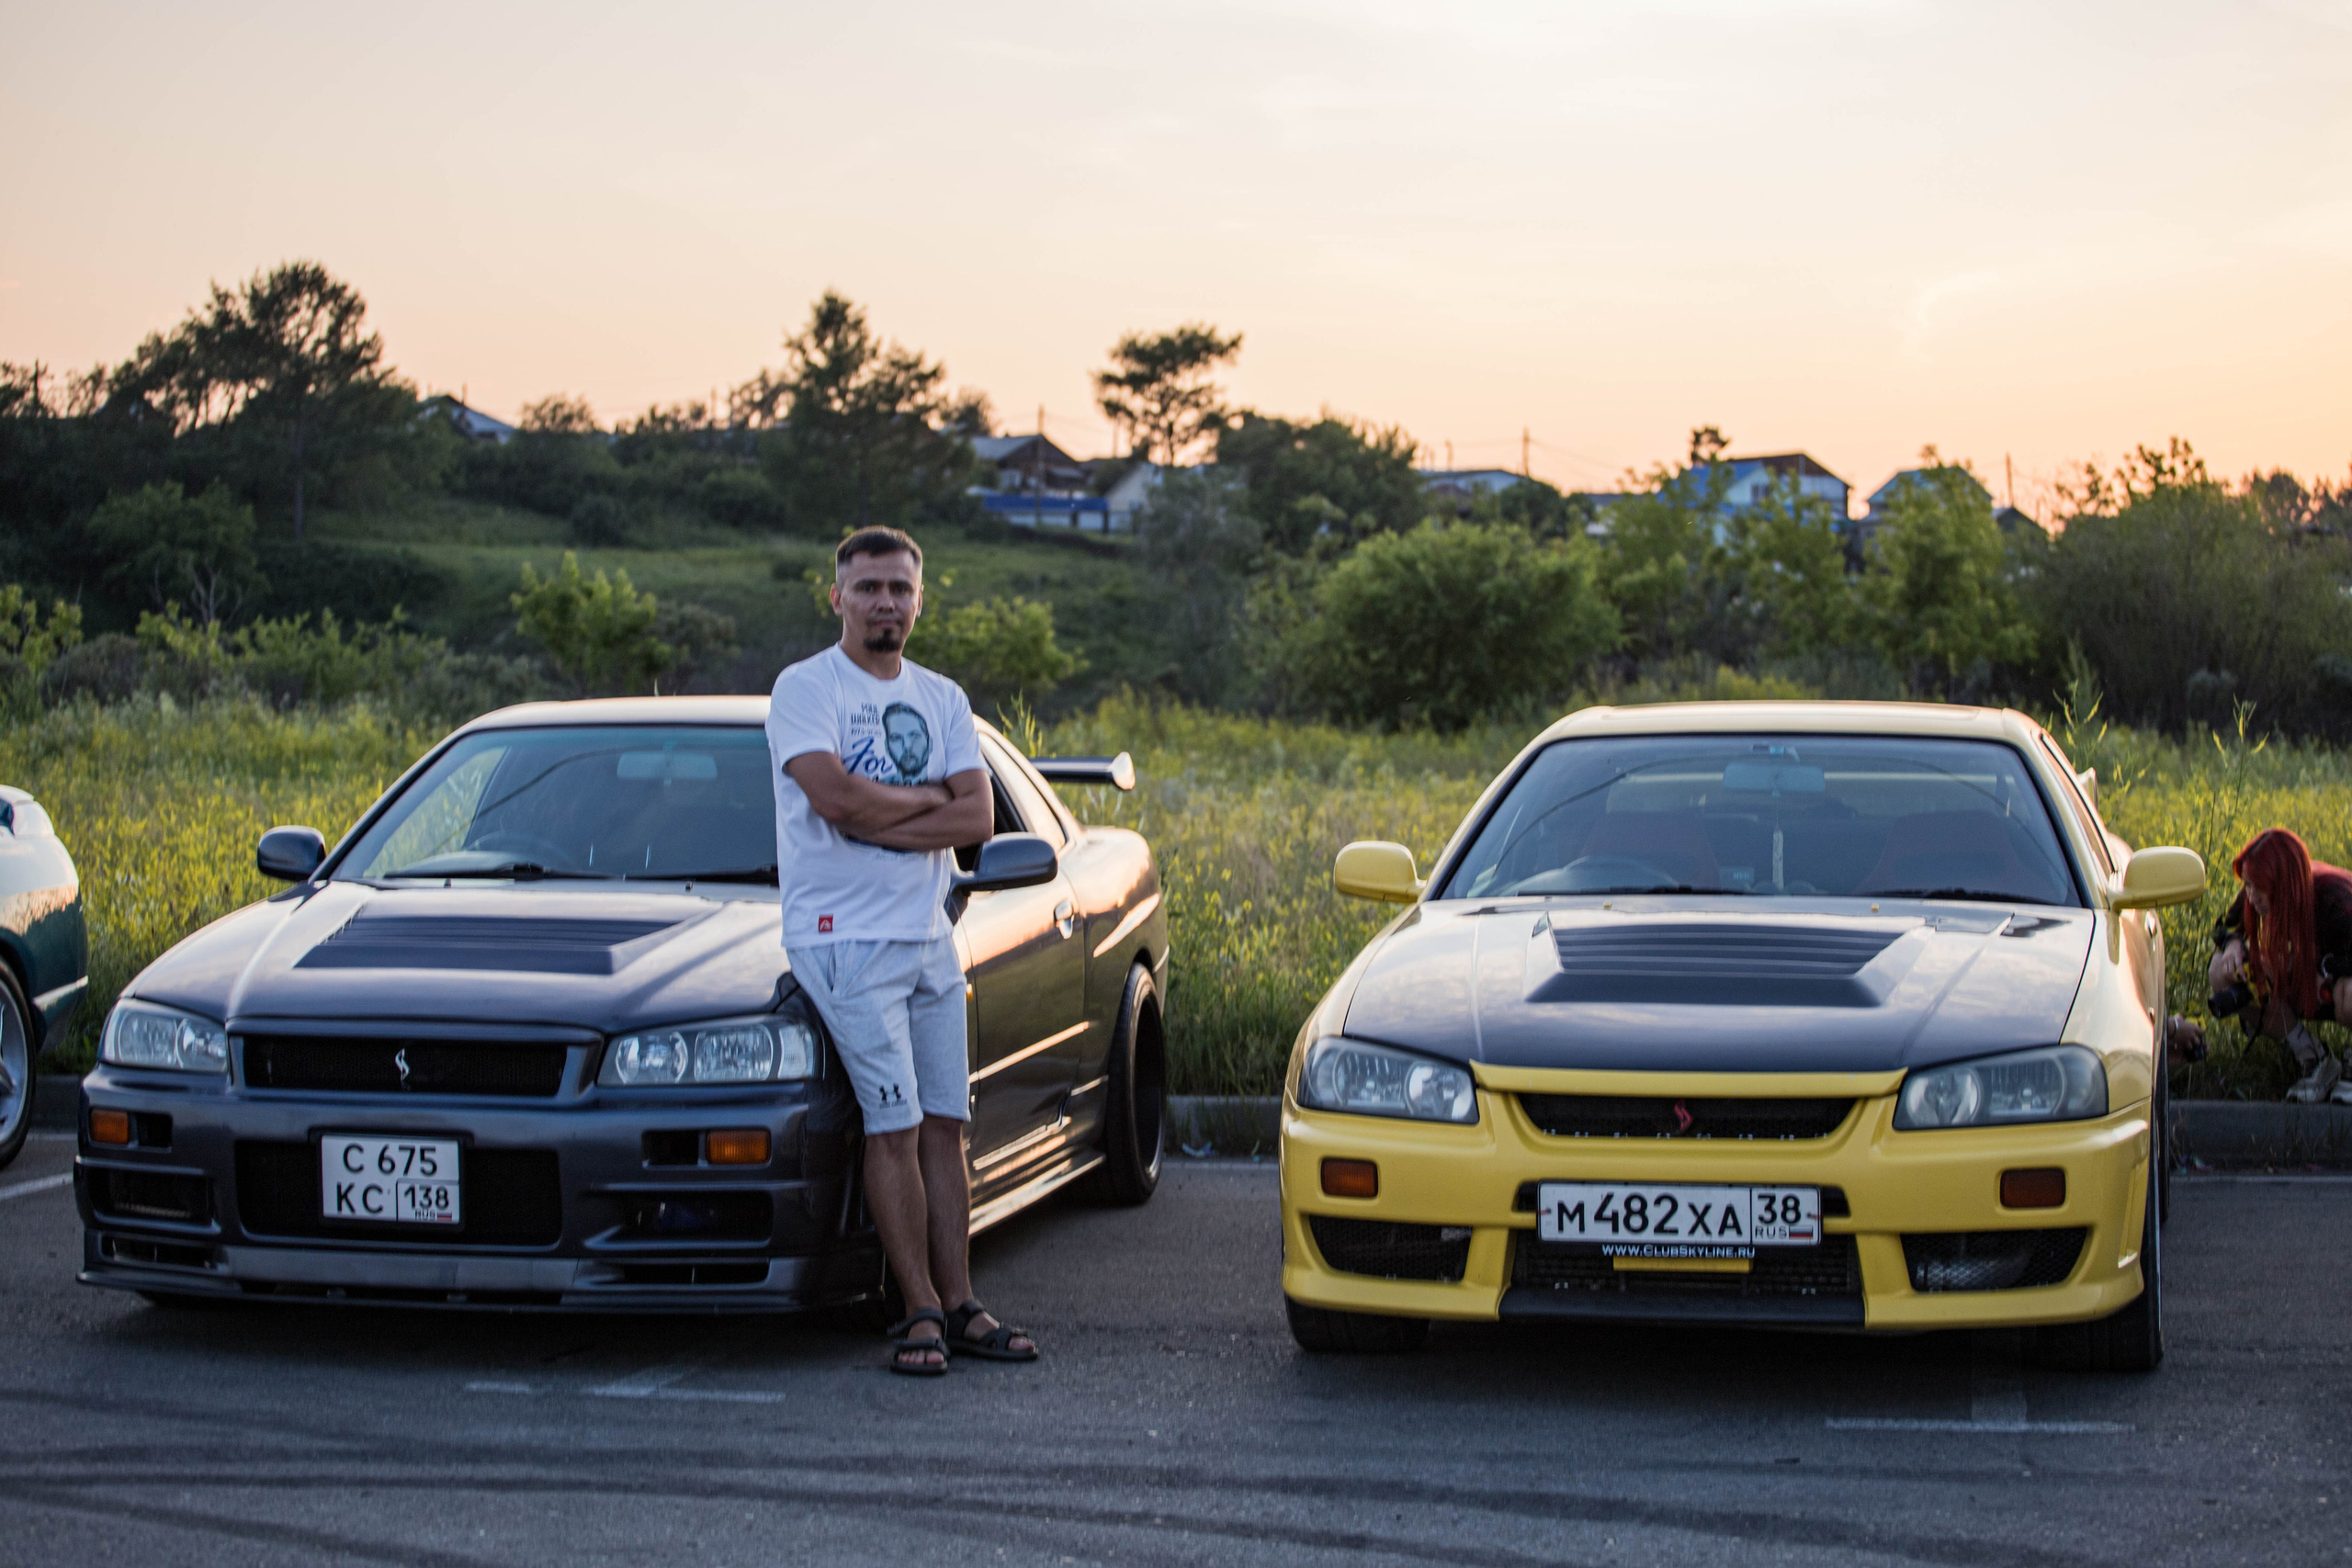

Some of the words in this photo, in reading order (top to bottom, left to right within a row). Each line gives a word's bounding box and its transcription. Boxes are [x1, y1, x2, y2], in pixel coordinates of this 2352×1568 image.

[336, 1181, 383, 1214] KC
[404, 1185, 449, 1210] 138
[1757, 1194, 1801, 1224] 38
[414, 1209, 436, 1221] RUS
[1754, 1225, 1787, 1239] RUS
